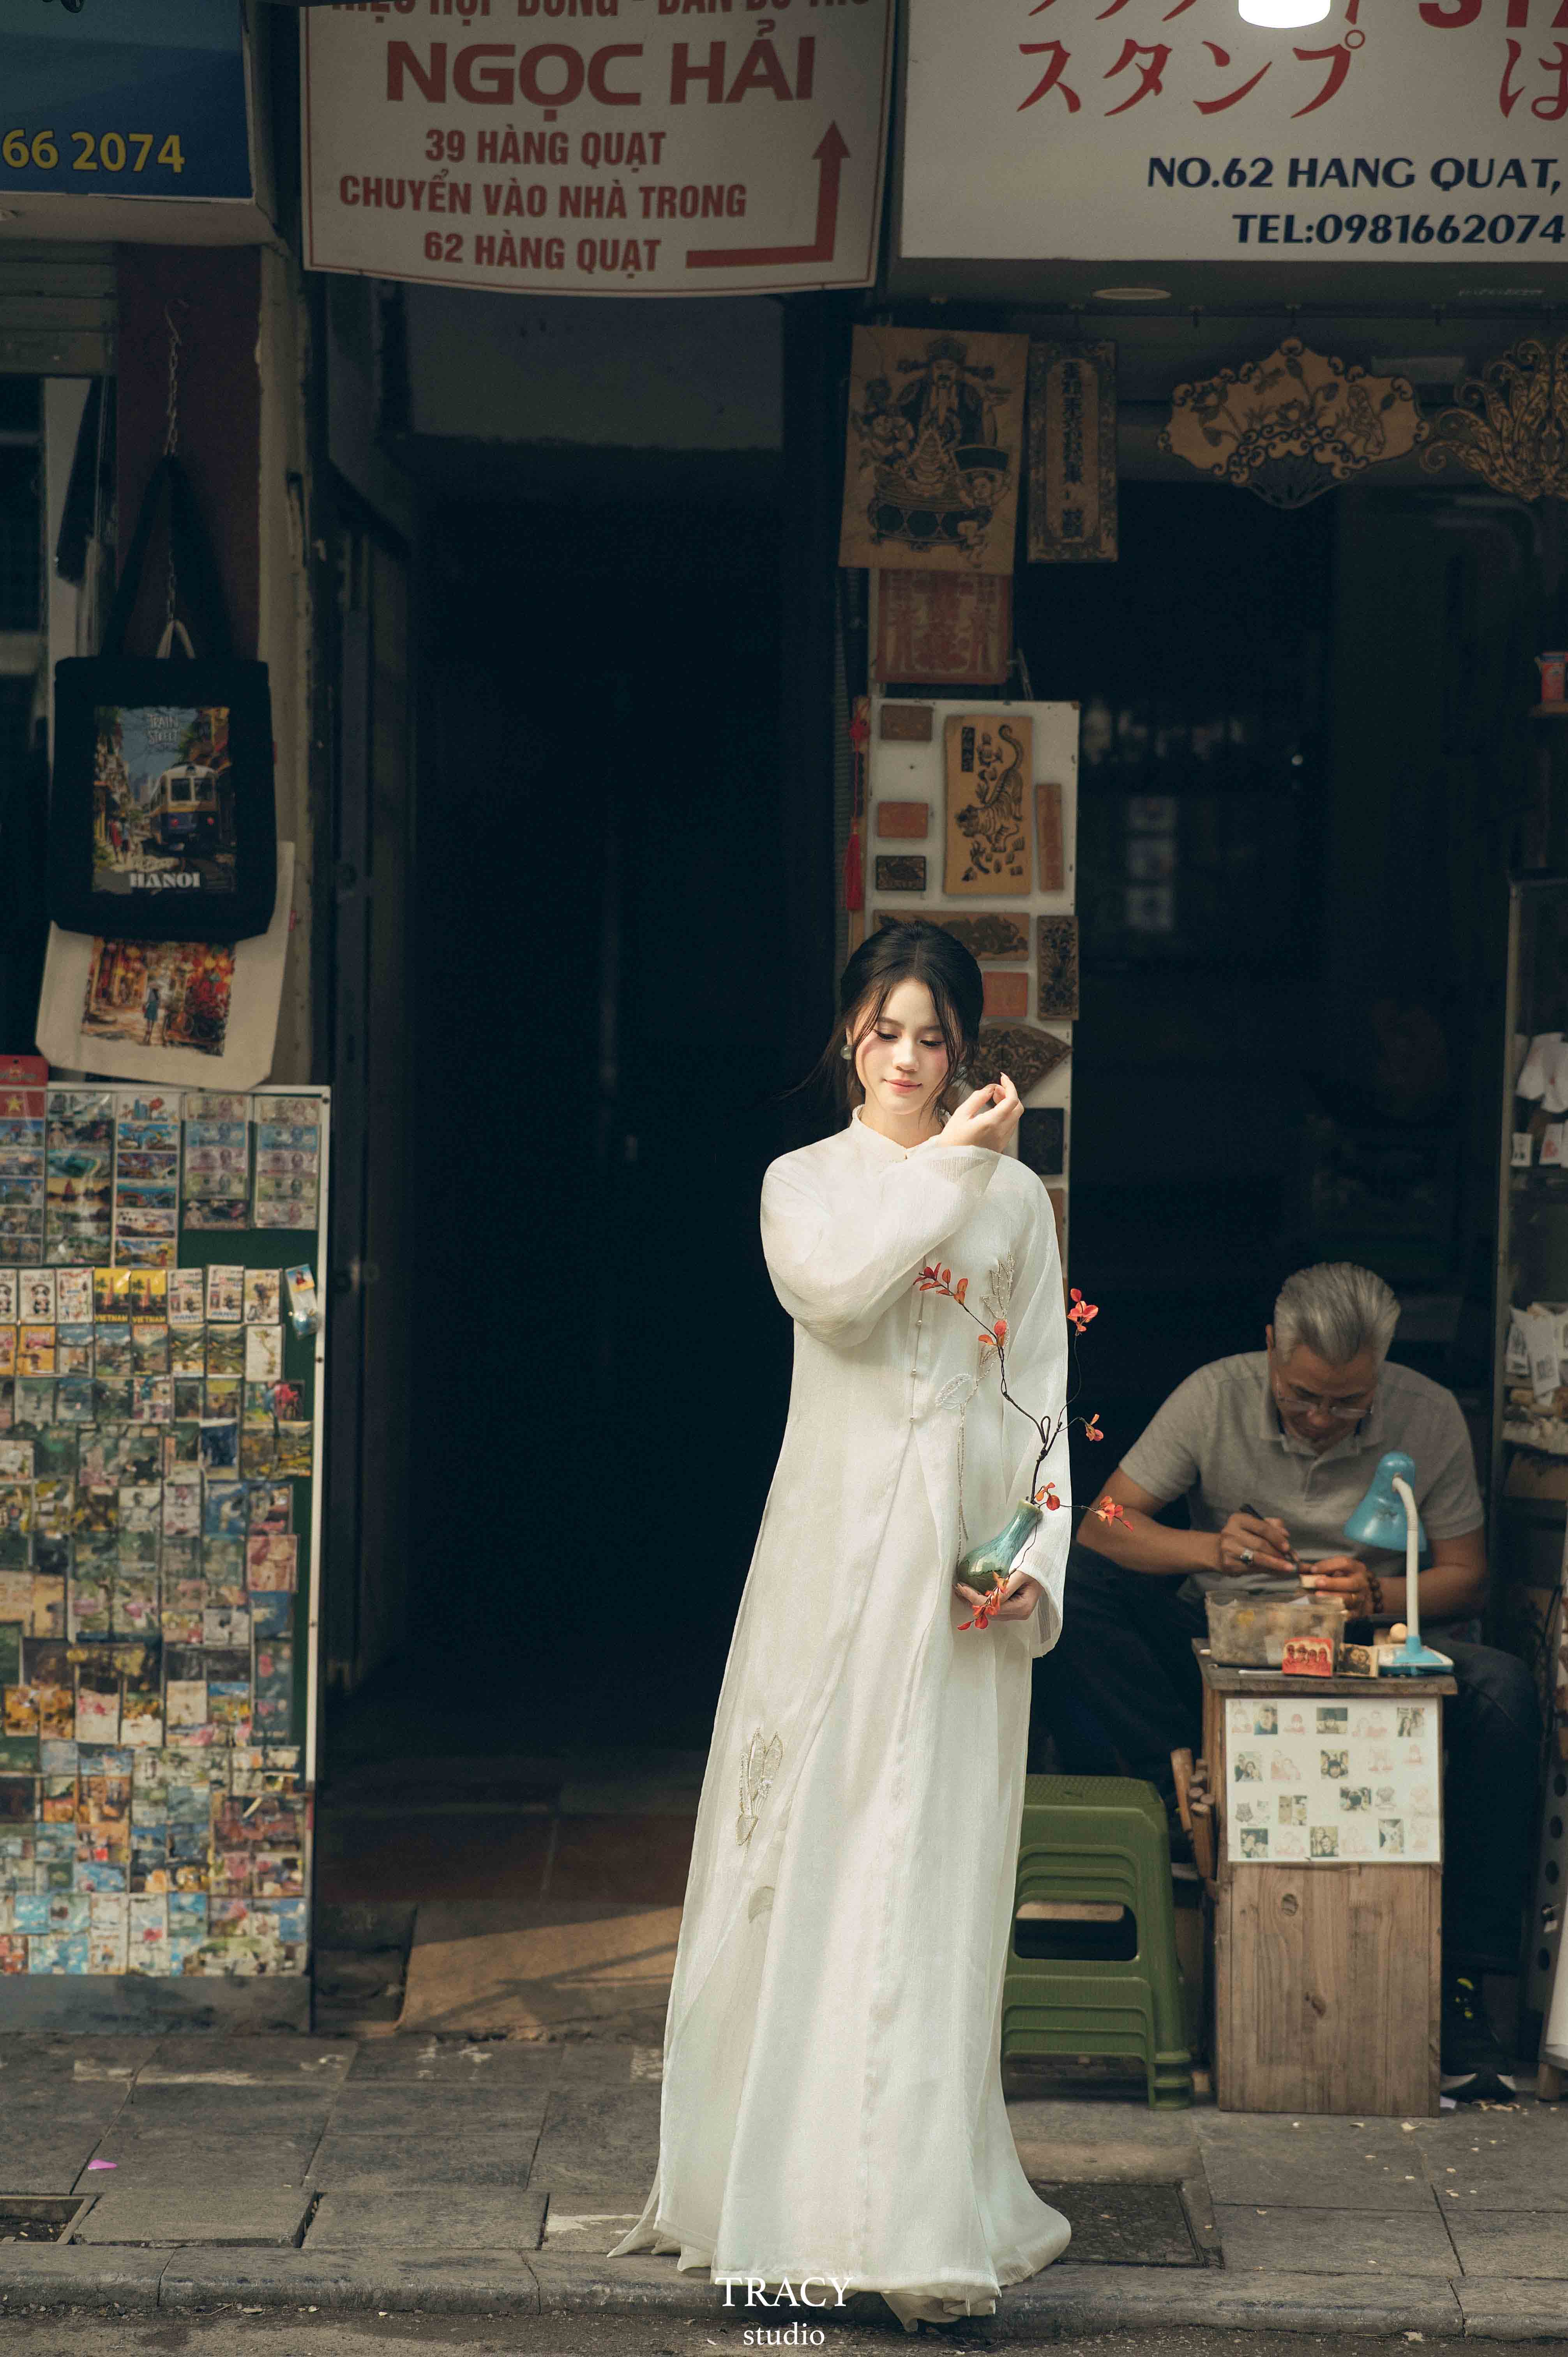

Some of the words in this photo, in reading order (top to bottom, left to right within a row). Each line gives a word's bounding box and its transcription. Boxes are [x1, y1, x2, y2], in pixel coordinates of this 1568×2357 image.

[387, 41, 643, 121] NGỌC
[671, 19, 815, 106] HẢI
[1017, 29, 1366, 118] スタンプ
[72, 132, 185, 173] 2074
[426, 129, 465, 163] 39
[477, 125, 569, 164] HÀNG
[582, 131, 666, 173] QUẠT
[340, 169, 471, 214] CHUYỂN
[484, 178, 547, 218] VÀO
[559, 180, 627, 219] NHÀ
[639, 184, 746, 219] TRONG
[1148, 158, 1273, 188] NO.62
[1288, 158, 1415, 188] HANG
[1430, 158, 1561, 196] QUAT,
[1233, 214, 1566, 244] TEL:0981662074
[424, 231, 463, 263] 62
[474, 230, 565, 269] HÀNG
[576, 238, 661, 278] QUẠT
[129, 872, 201, 888] HANOI
